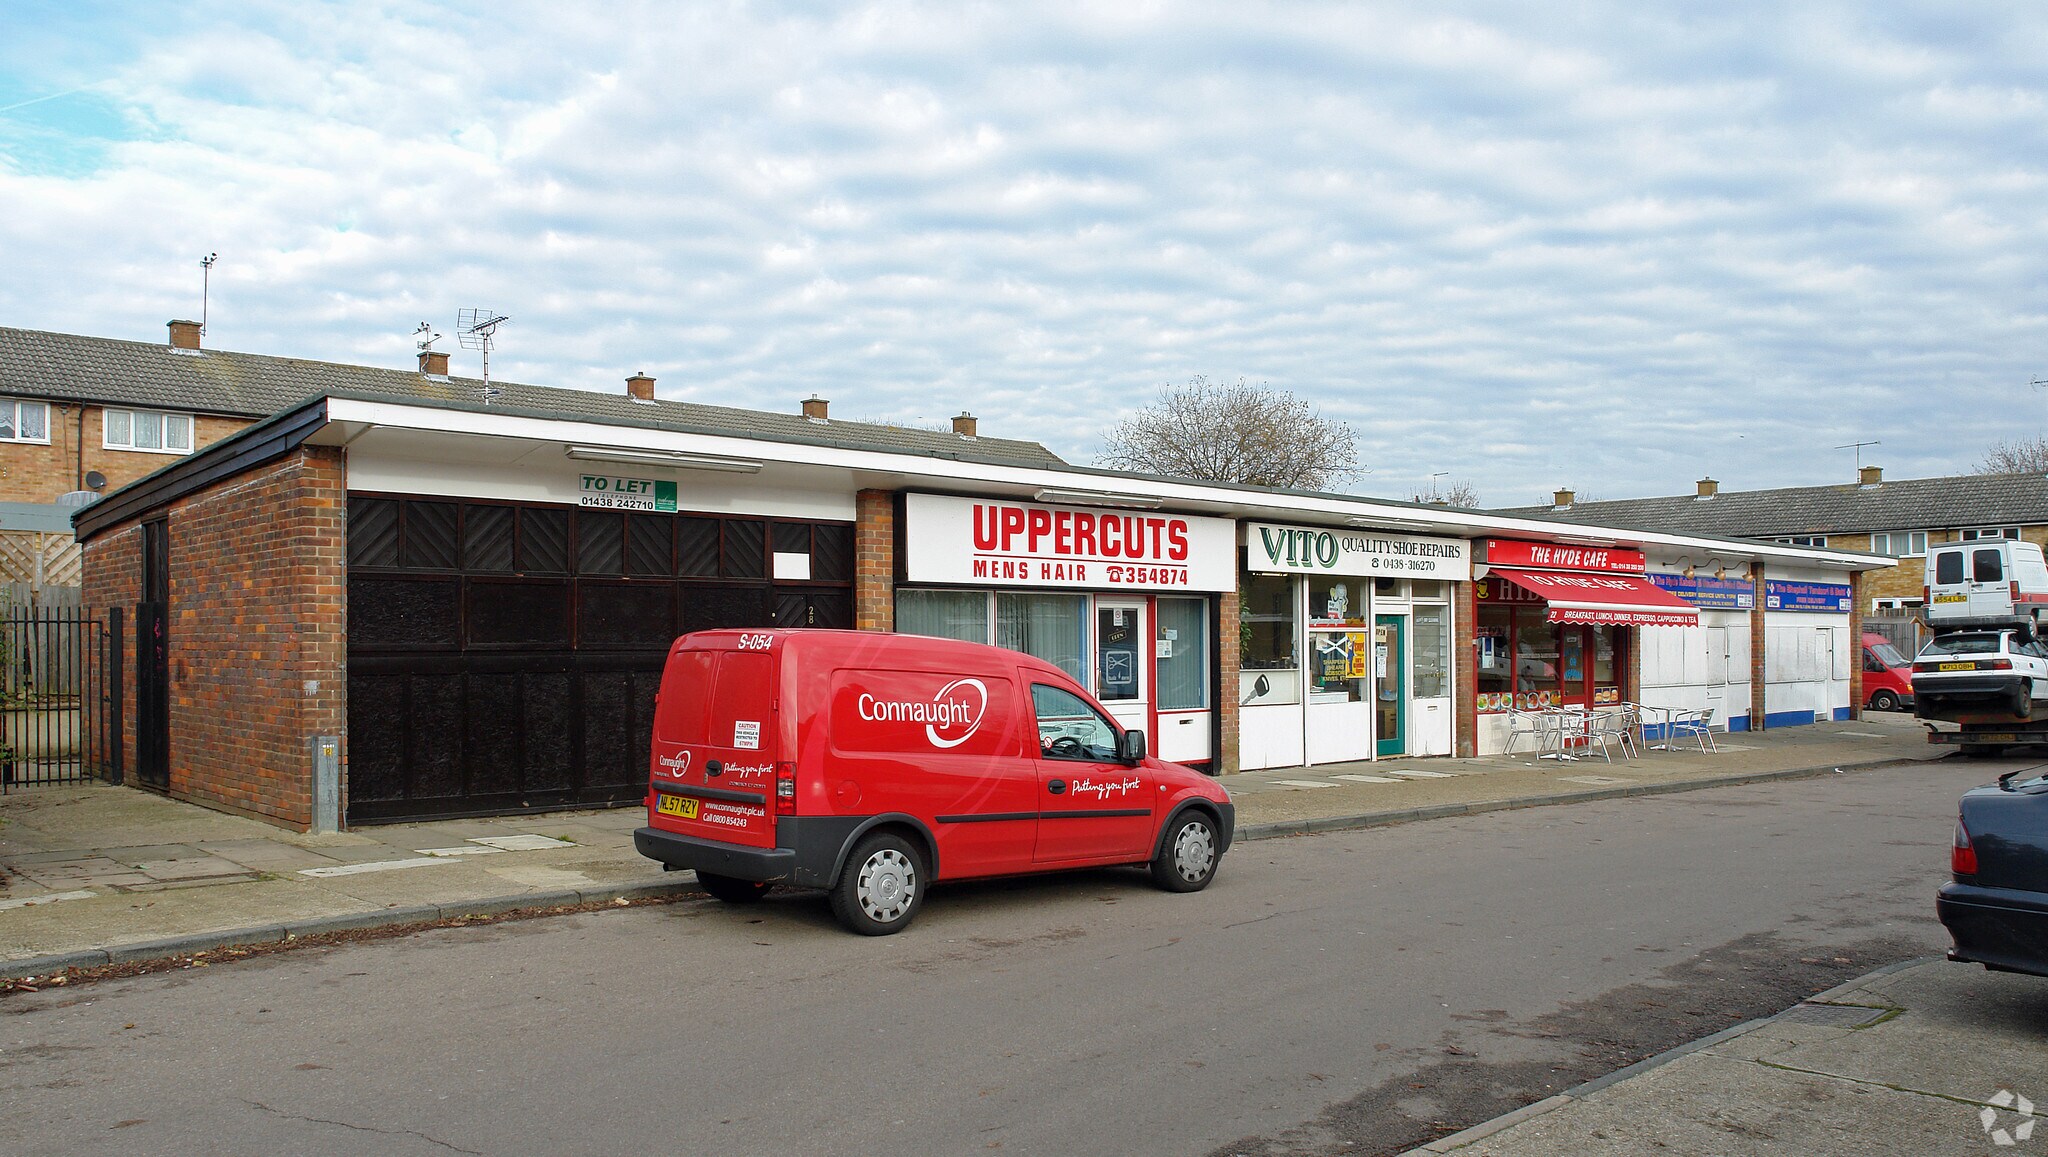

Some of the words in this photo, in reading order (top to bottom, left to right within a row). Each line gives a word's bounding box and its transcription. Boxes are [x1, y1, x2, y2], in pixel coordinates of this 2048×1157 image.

[583, 476, 608, 490] TO
[615, 480, 651, 493] LET
[582, 497, 613, 506] 01438
[616, 499, 653, 510] 242710
[973, 504, 1188, 560] UPPERCUTS
[1258, 526, 1340, 568] VITO
[1342, 537, 1392, 554] QUALITY
[1392, 541, 1418, 555] SHOE
[1419, 543, 1461, 558] REPAIRS
[1383, 558, 1435, 571] 0438-316270
[1531, 546, 1551, 563] THE
[1553, 548, 1582, 565] HYDE
[1583, 550, 1608, 567] CAFE
[973, 560, 1028, 579] MENS
[1041, 562, 1086, 581] HAIR
[1125, 567, 1188, 585] 354874
[1592, 577, 1639, 590] CAFE
[1564, 611, 1595, 620] BREAKFAST,
[1595, 612, 1613, 621] LUNCH,
[1613, 613, 1632, 621] DINNER,
[738, 633, 774, 650] S-054
[858, 693, 971, 729] Connaught
[659, 754, 685, 770] Connaught
[723, 762, 746, 778] Putting
[745, 766, 758, 778] you
[757, 763, 774, 777] first
[1072, 778, 1105, 800] Putting
[1105, 782, 1122, 799] you
[1122, 776, 1140, 796] first
[660, 795, 680, 811] NL57
[680, 798, 698, 815] RZY
[705, 802, 765, 817] www.connaught.plc.uk
[702, 812, 712, 821] Call
[712, 814, 726, 824] 0800
[726, 817, 747, 828] 854243
